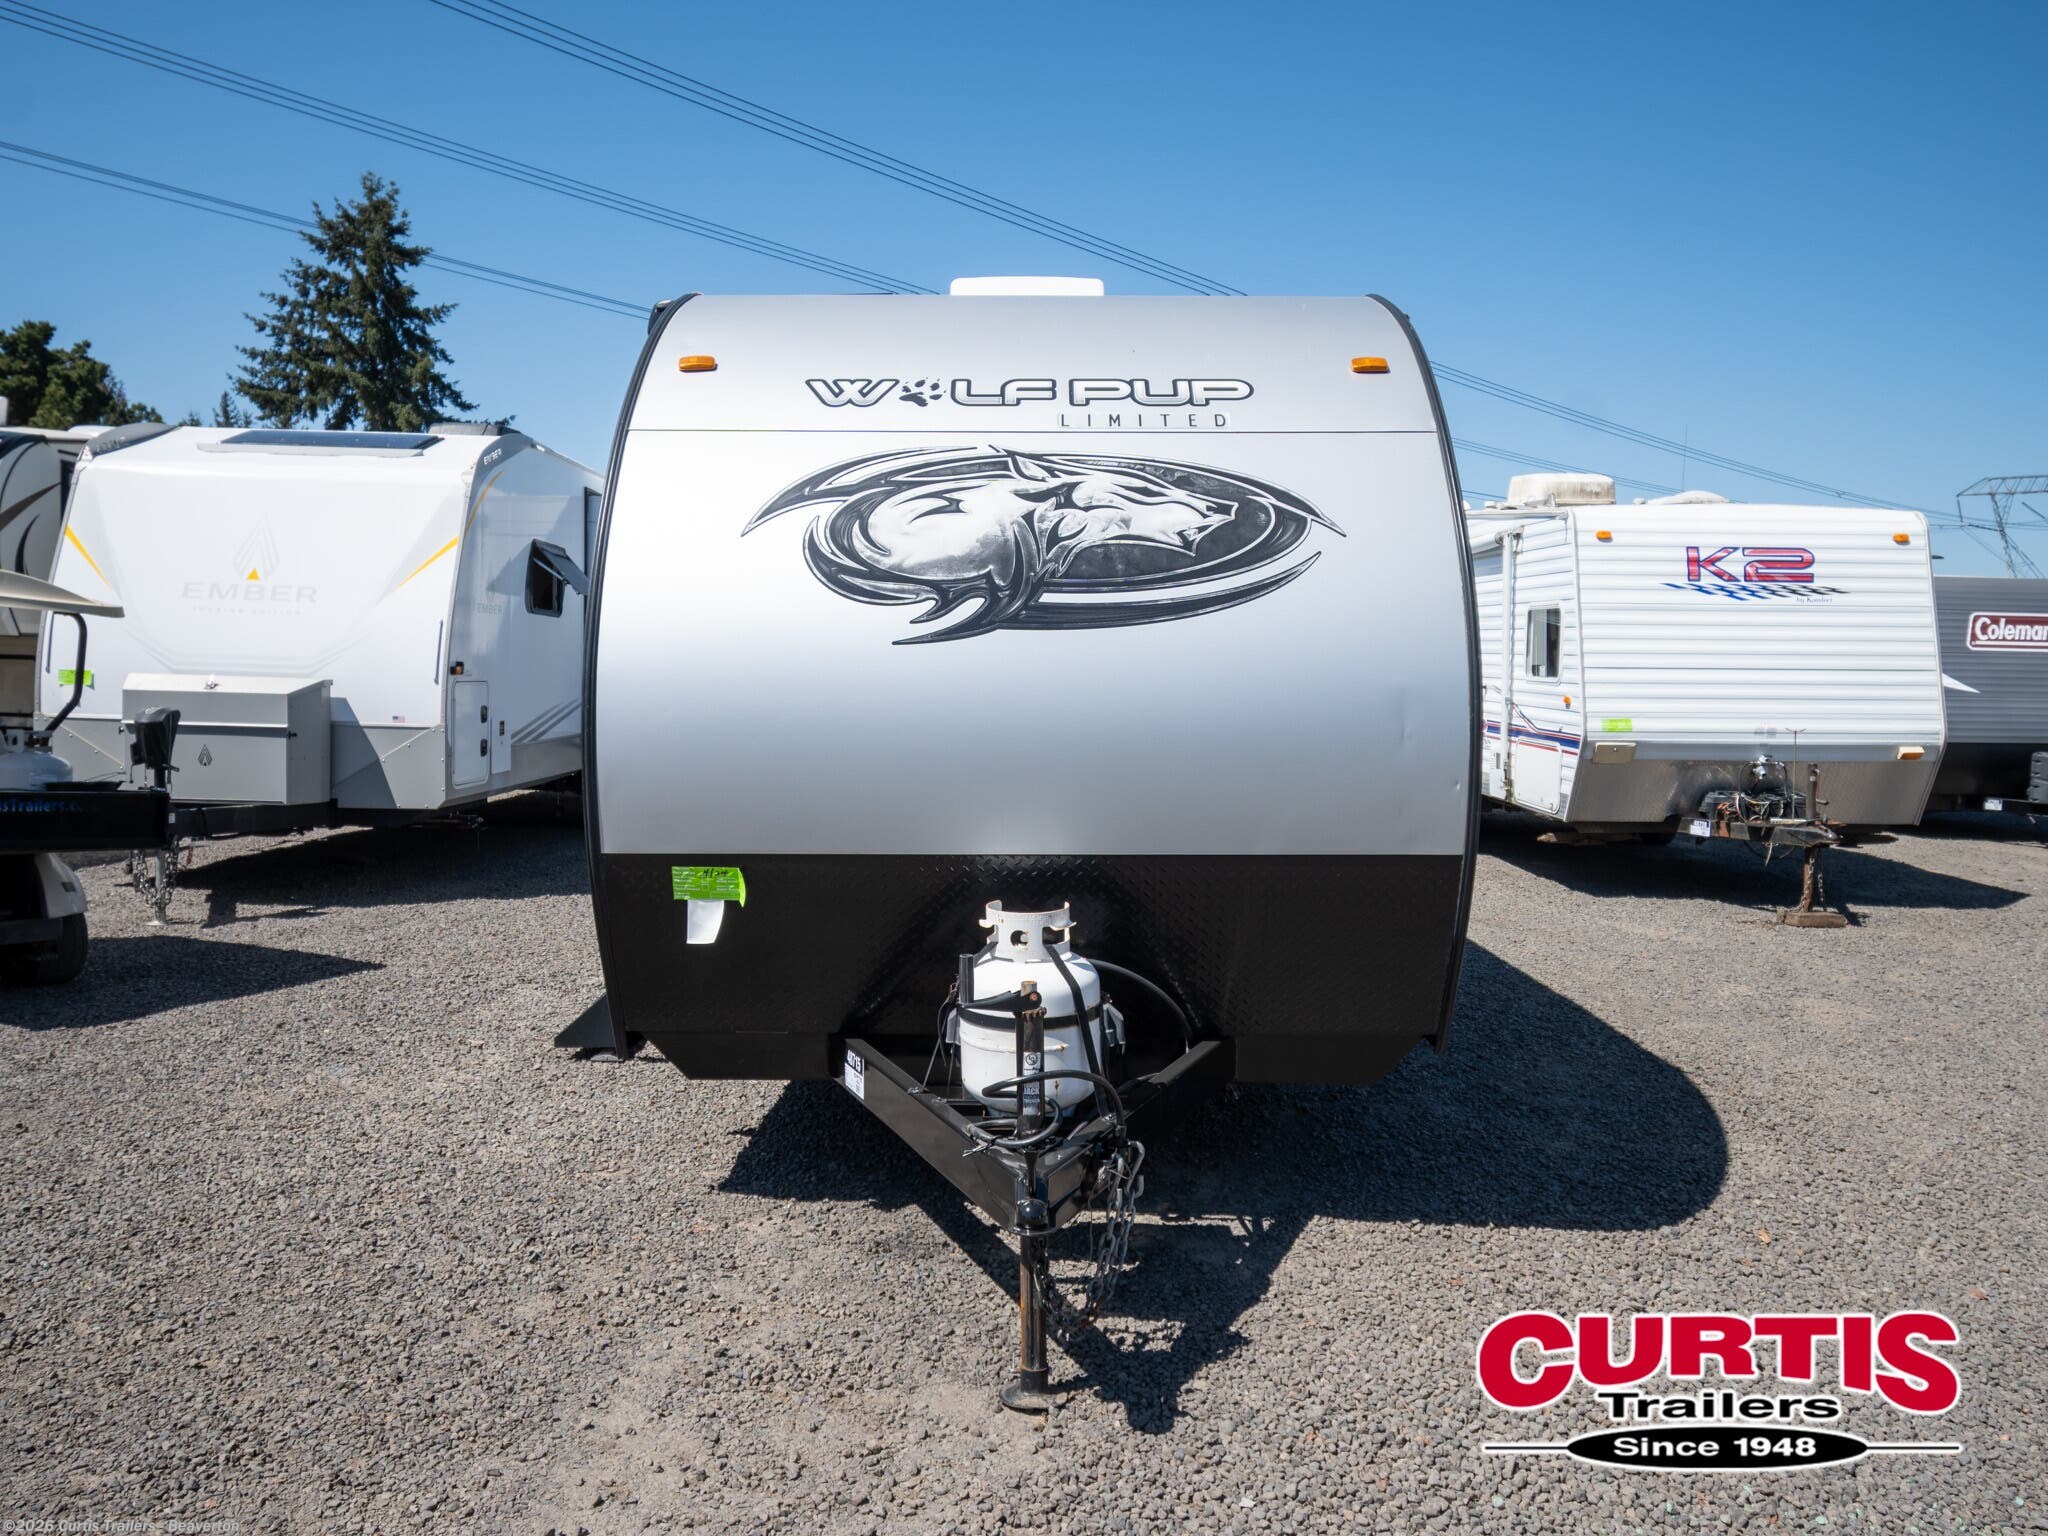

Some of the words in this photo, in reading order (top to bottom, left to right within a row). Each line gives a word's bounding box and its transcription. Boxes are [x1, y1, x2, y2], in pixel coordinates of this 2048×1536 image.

[1068, 378, 1255, 408] PUP
[1060, 413, 1227, 427] LIMITED
[1686, 546, 1815, 583] K2
[181, 581, 318, 603] EMBER
